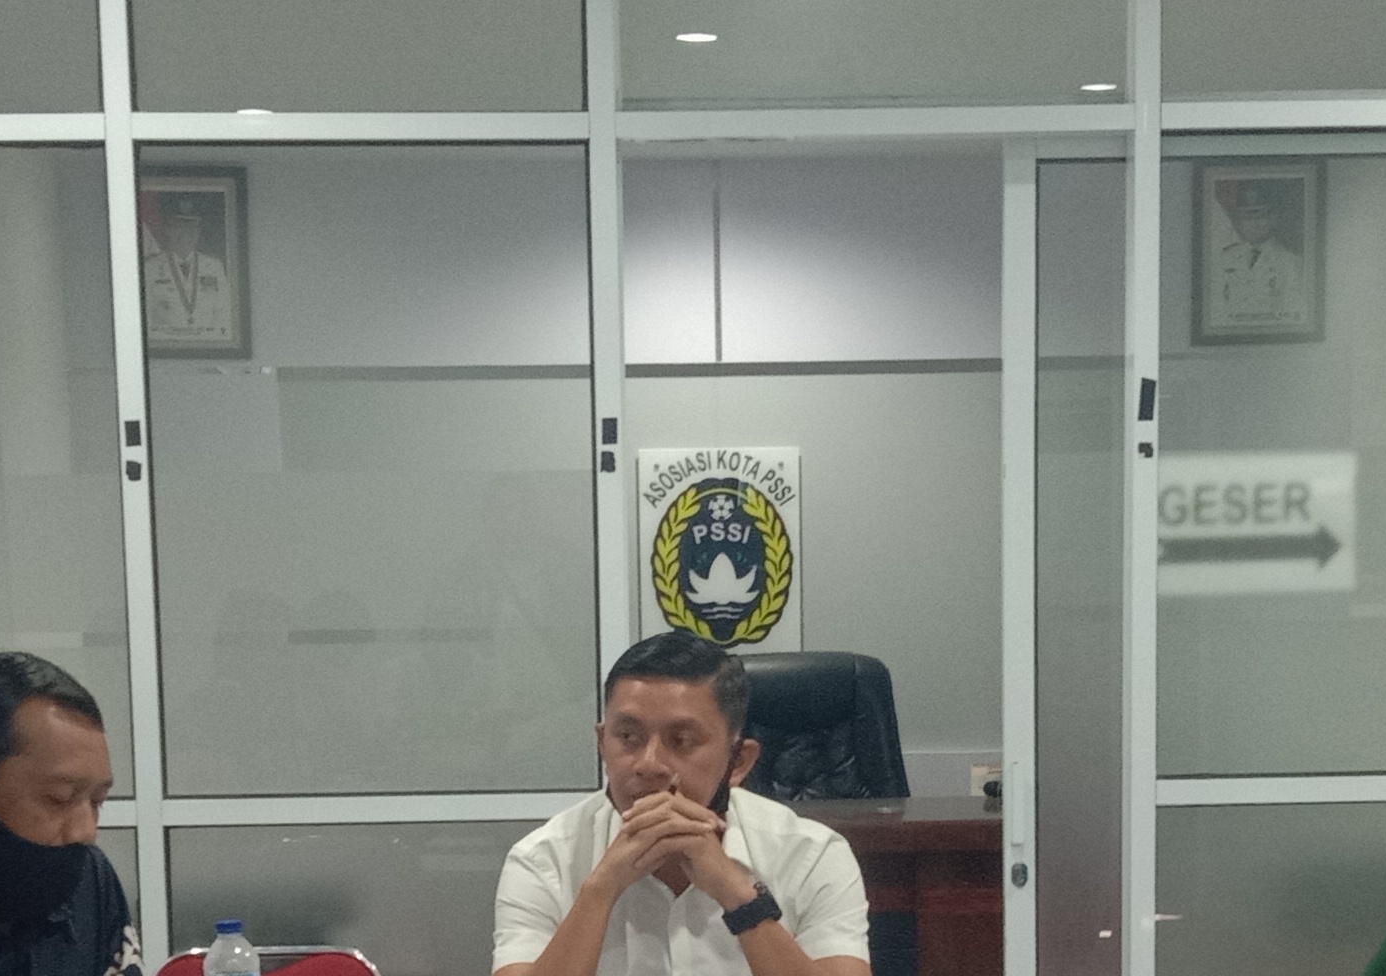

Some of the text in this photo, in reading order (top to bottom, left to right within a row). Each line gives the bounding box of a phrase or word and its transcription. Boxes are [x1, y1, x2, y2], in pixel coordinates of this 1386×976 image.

[643, 450, 796, 508] ASOSIASI KOTA PSSI
[1158, 482, 1312, 526] GESER
[692, 522, 751, 544] PSSI
